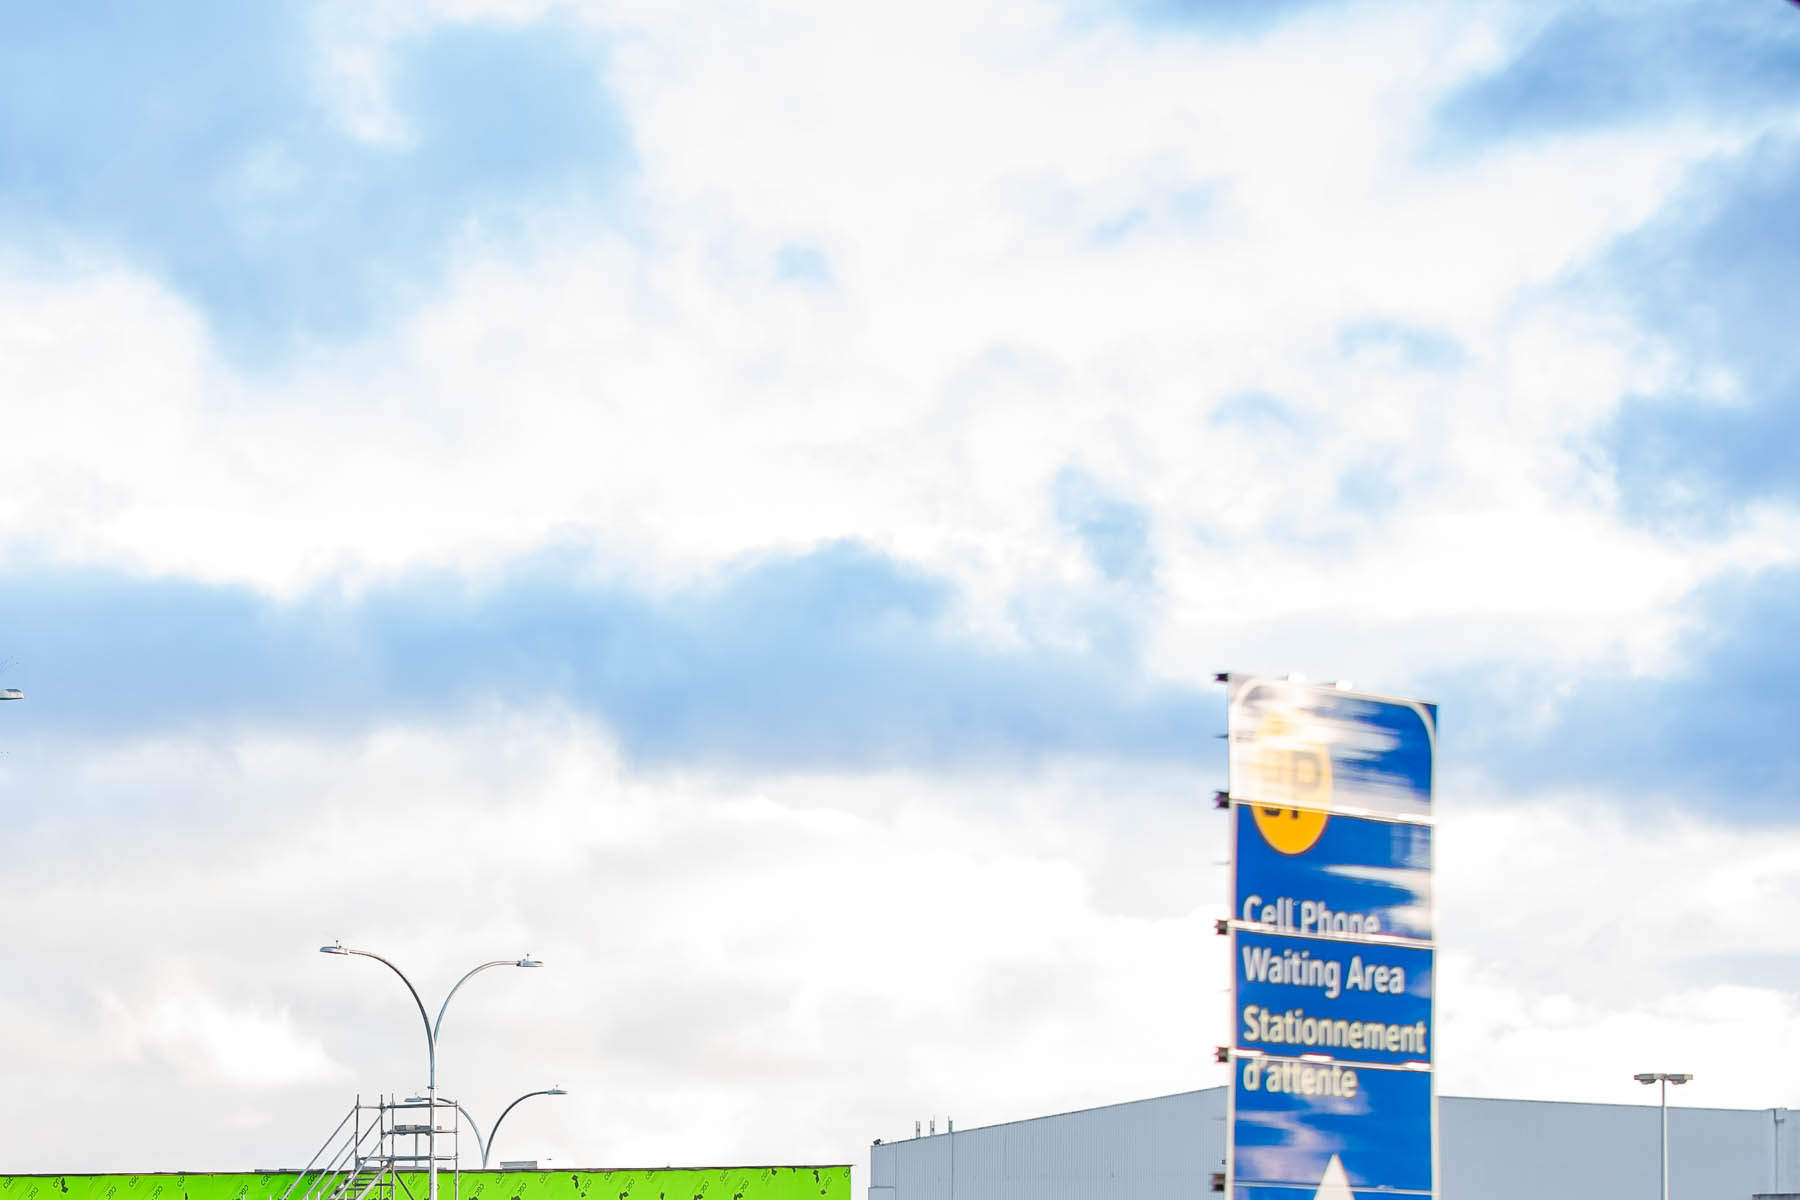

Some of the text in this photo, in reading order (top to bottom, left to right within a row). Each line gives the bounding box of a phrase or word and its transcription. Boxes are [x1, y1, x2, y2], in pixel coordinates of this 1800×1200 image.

[1243, 895, 1381, 934] Cell Phone
[1242, 946, 1406, 999] Waiting Area
[1243, 1004, 1427, 1054] Stationnement
[1243, 1056, 1359, 1098] d'attente
